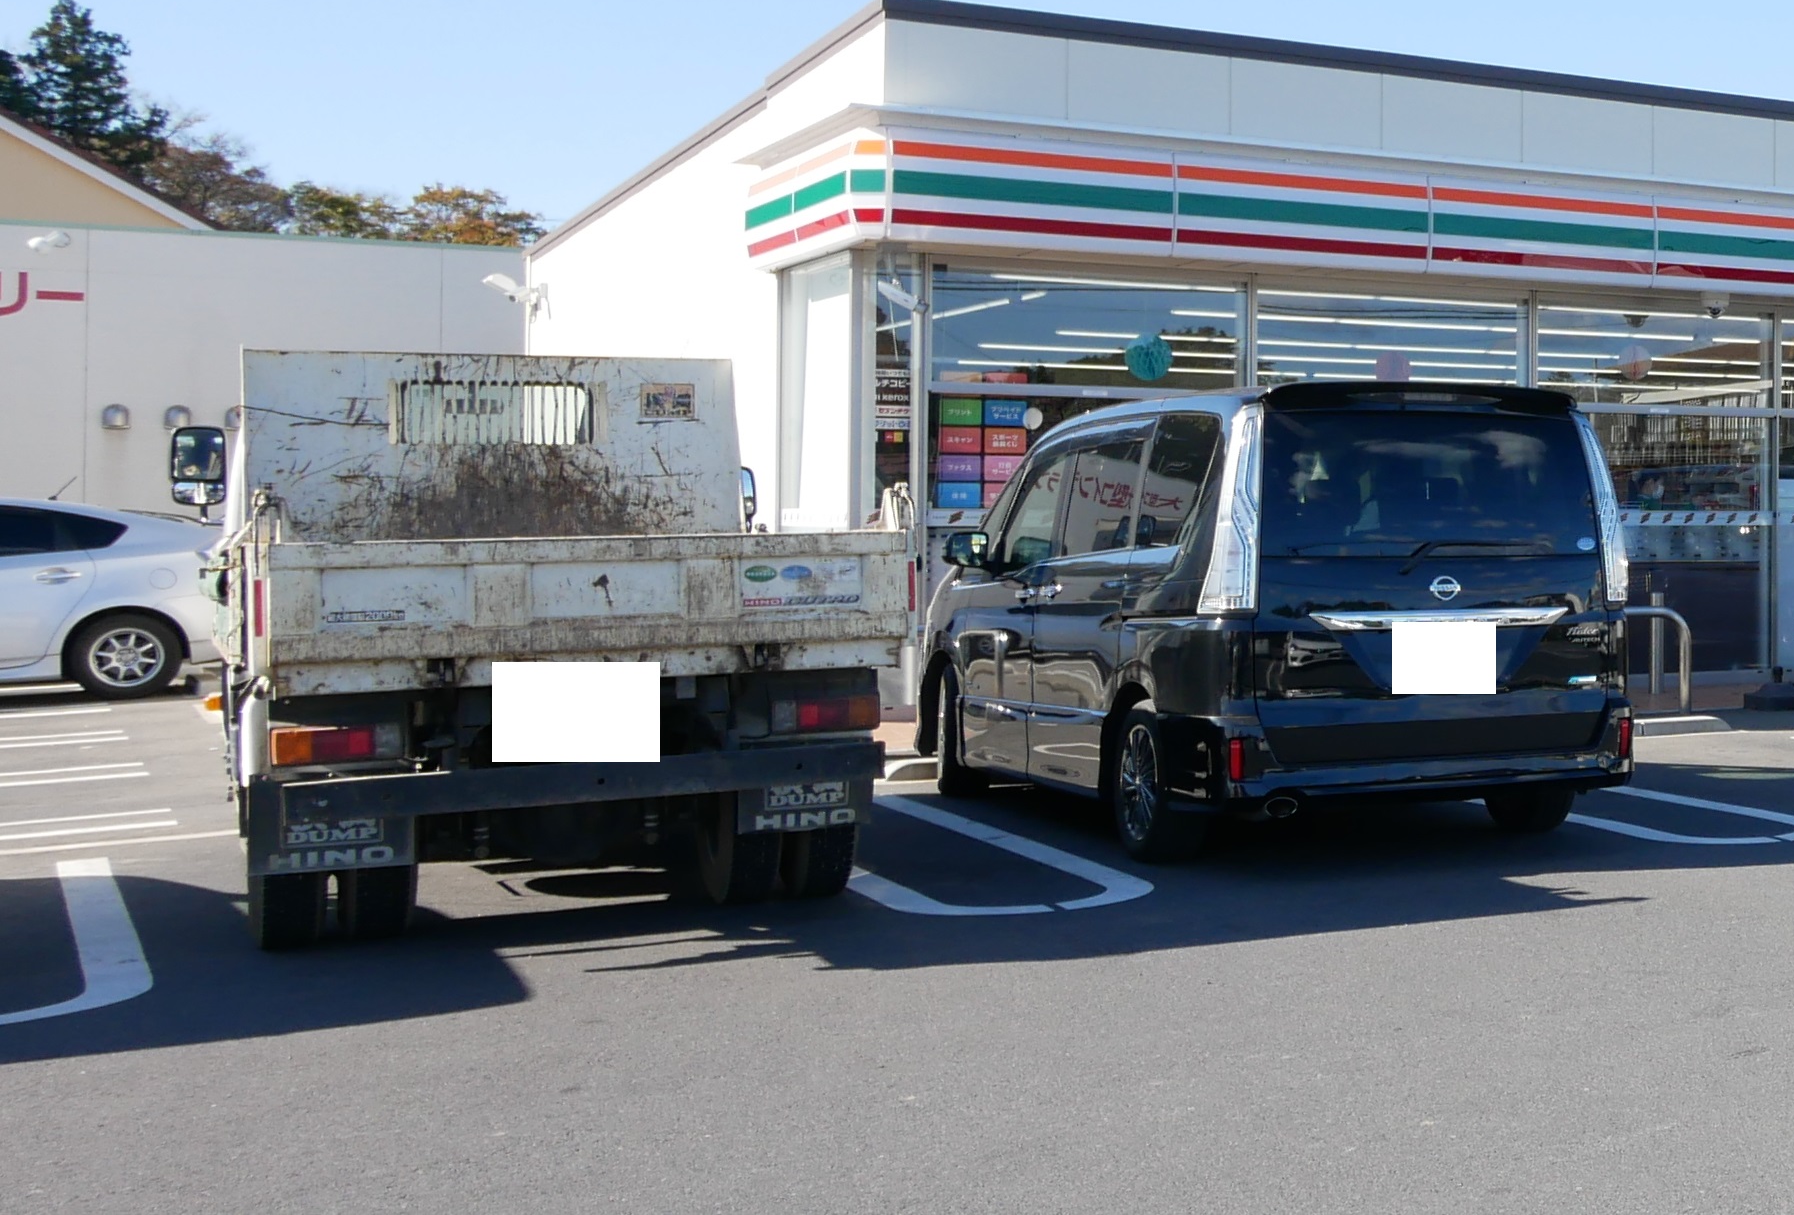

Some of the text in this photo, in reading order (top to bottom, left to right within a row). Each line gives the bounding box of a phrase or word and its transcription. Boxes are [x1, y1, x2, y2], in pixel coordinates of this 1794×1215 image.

[770, 791, 844, 806] DUMP
[756, 808, 856, 830] HINO
[286, 827, 378, 844] DUMP
[269, 846, 394, 869] HINO
